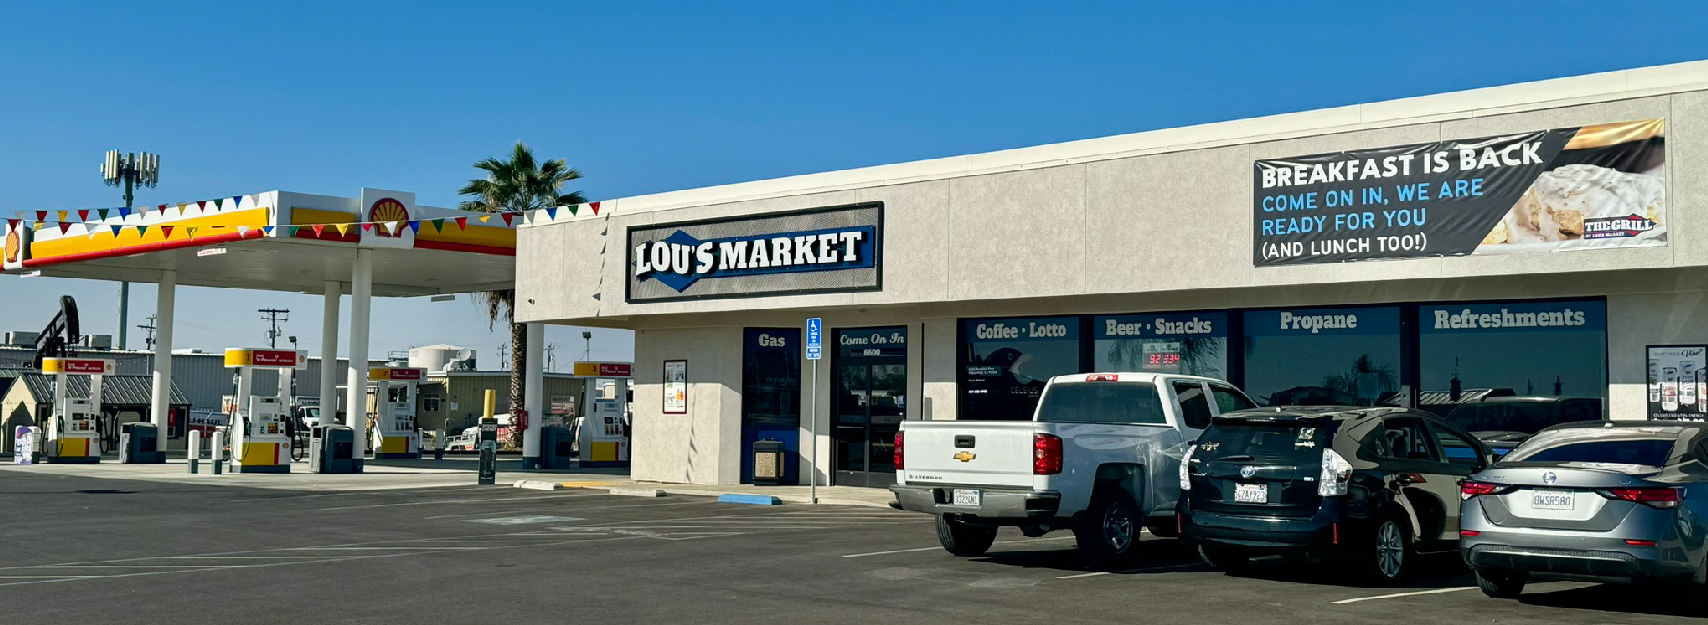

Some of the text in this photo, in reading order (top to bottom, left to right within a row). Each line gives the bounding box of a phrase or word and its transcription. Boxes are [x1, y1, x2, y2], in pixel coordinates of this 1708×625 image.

[1262, 141, 1544, 188] BREAKFAST IS BACK
[1262, 178, 1484, 212] COME ON IN, WE ARE
[1262, 208, 1427, 236] READY FOR YOU
[635, 231, 863, 277] LOU'S MARKET
[1262, 231, 1427, 260] (AND LUNCH TOO!)
[1105, 317, 1212, 336] Beer Snacks
[1280, 311, 1358, 334] Propane
[1434, 308, 1586, 329] Refreshments
[758, 333, 786, 347] Gas
[839, 332, 905, 346] Come On In
[976, 322, 1066, 339] Coffee Lotto
